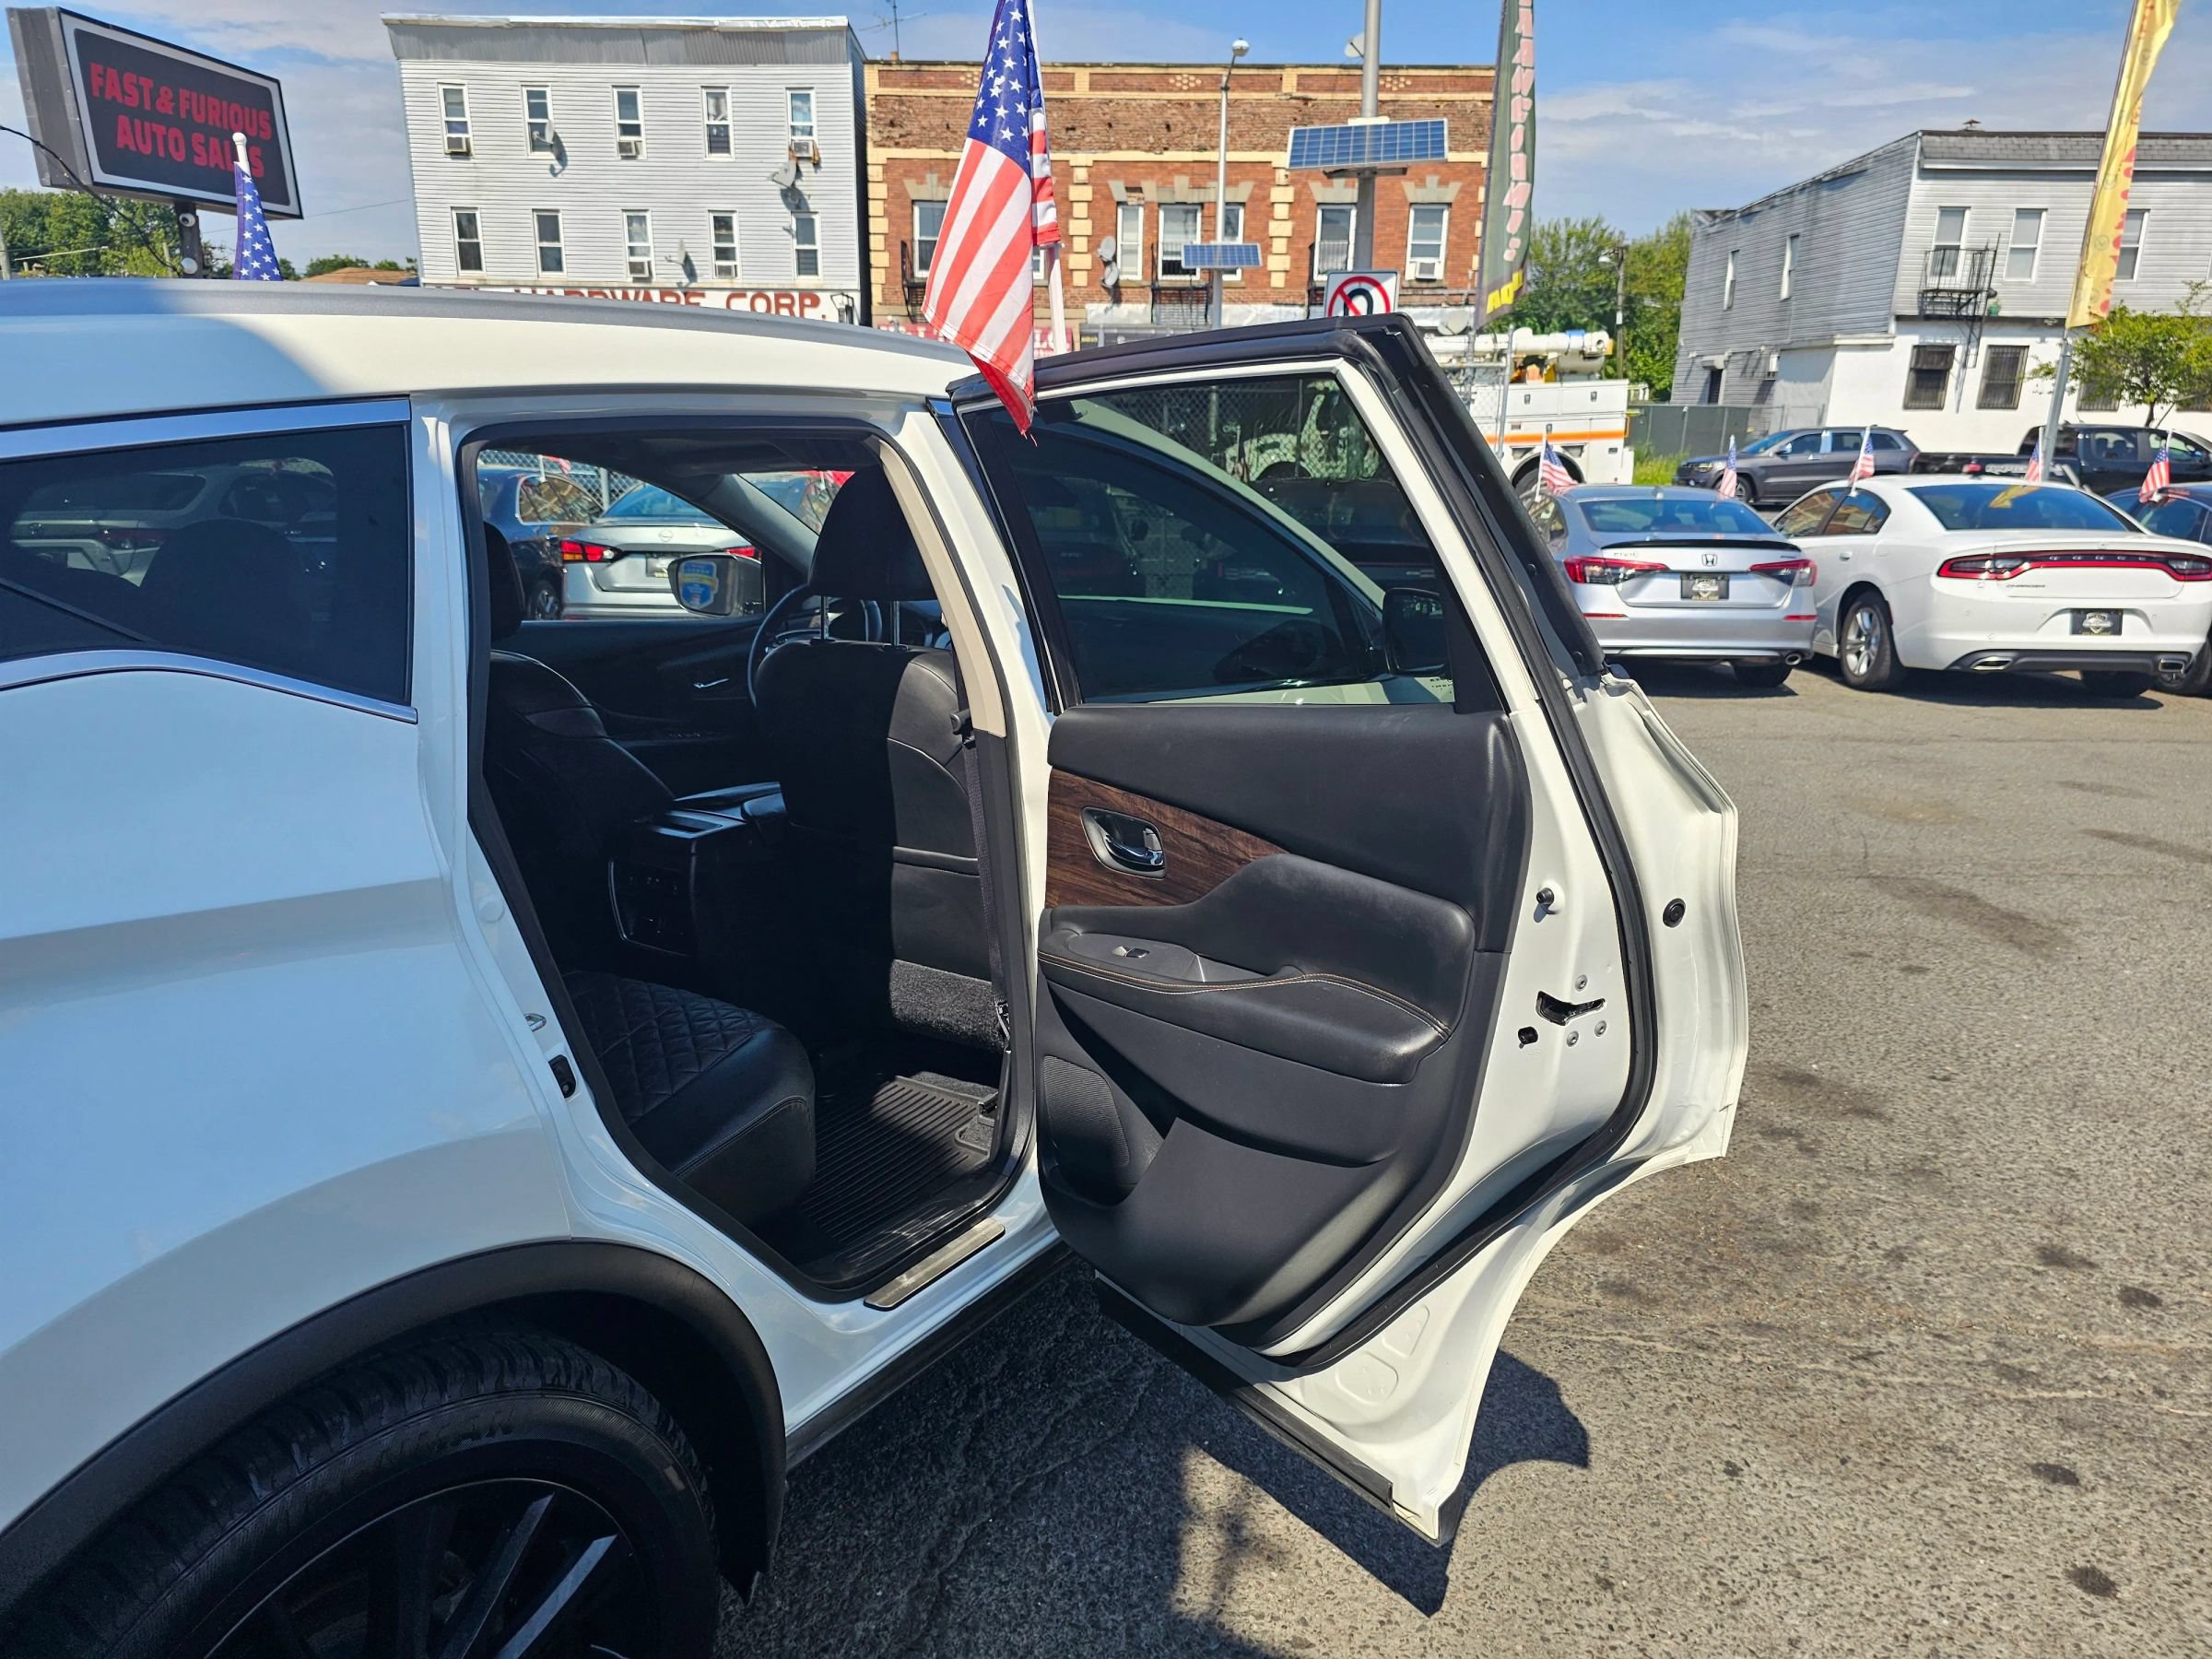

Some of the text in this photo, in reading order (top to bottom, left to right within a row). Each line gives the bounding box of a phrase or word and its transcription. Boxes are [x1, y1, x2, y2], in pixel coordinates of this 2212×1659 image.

[89, 62, 272, 140] FAST & FURIOUS
[116, 114, 265, 178] AUTO SALS
[514, 288, 826, 320] WARE CORP.
